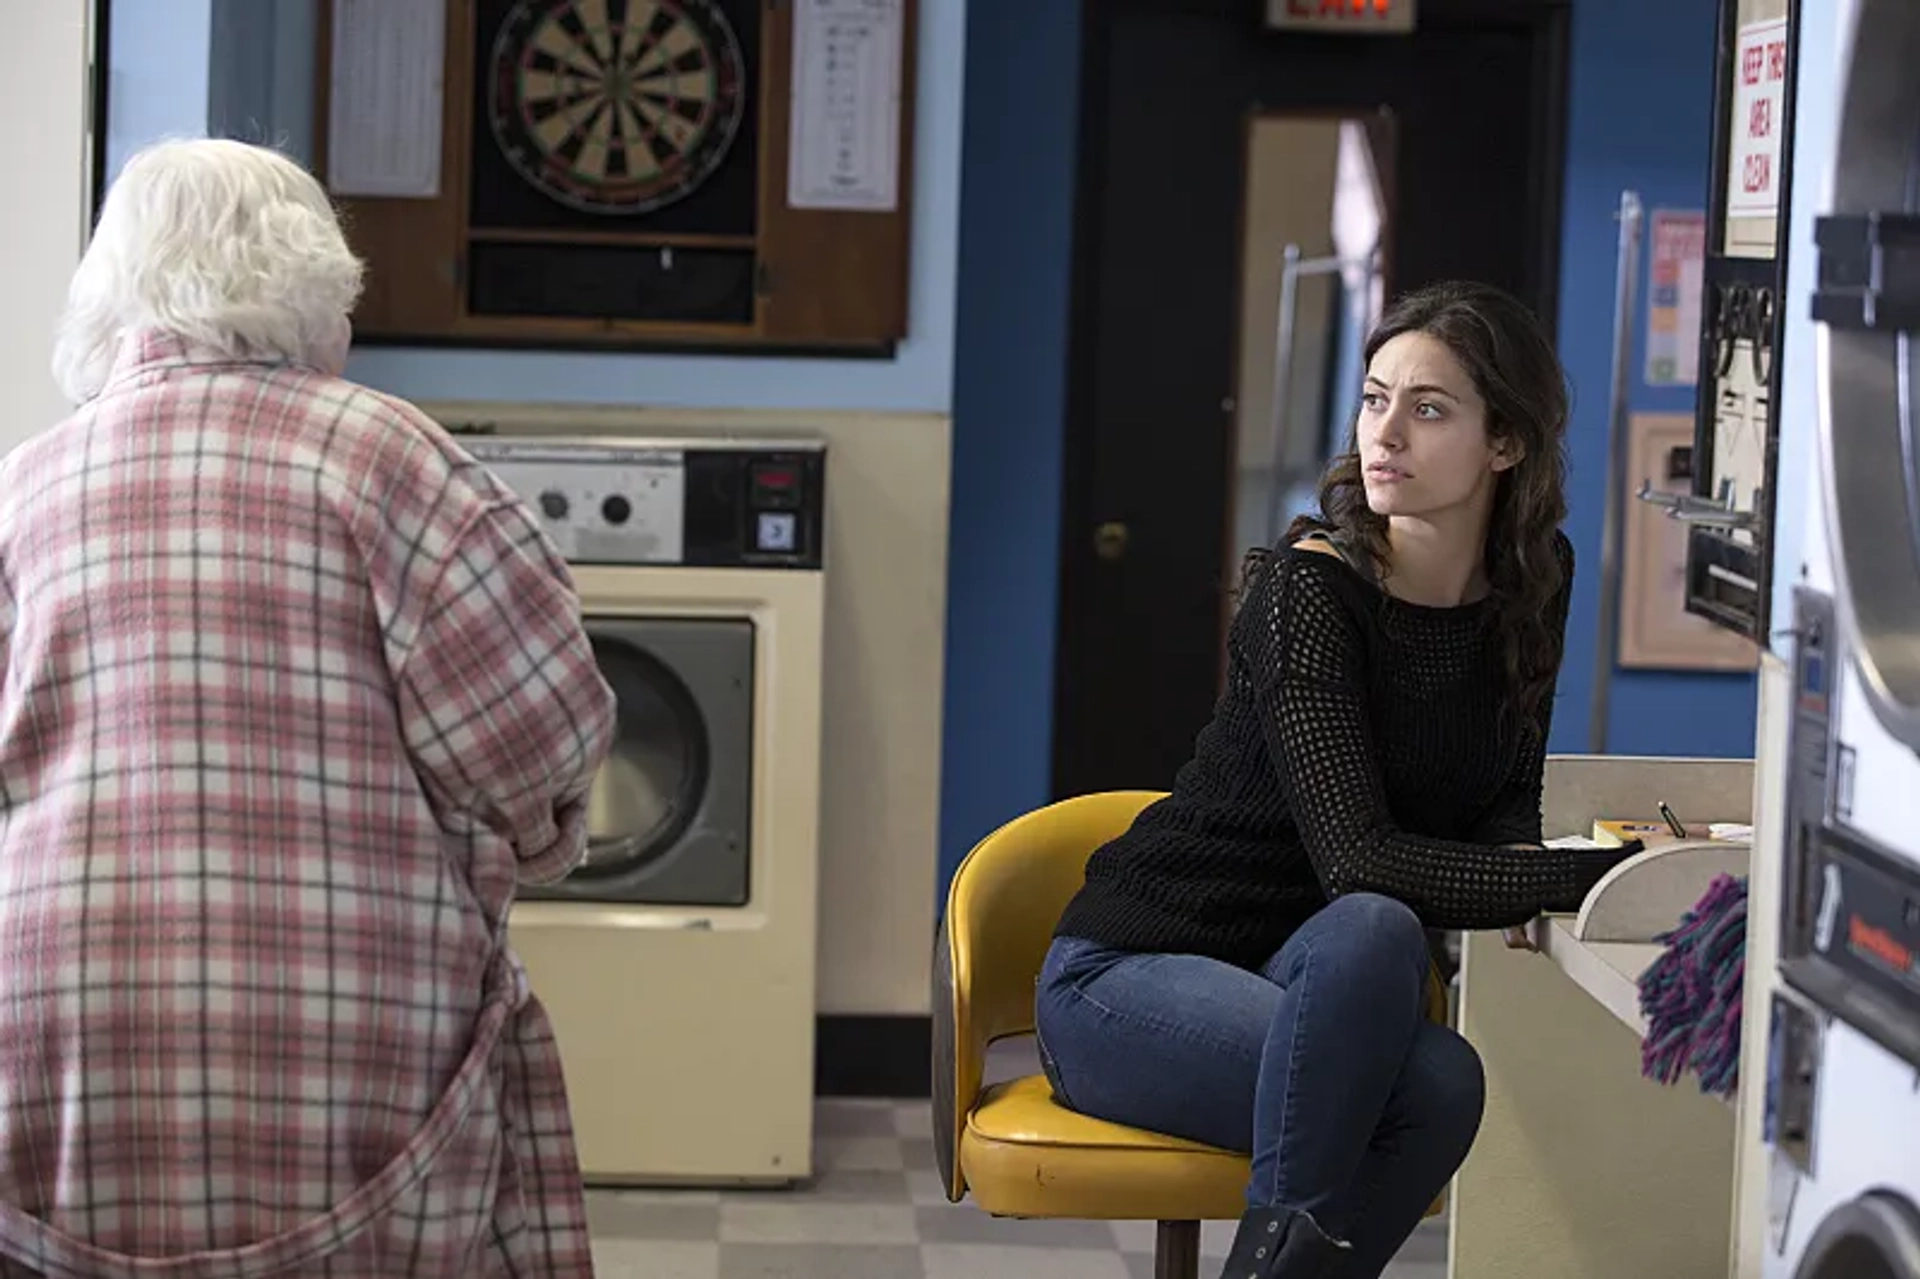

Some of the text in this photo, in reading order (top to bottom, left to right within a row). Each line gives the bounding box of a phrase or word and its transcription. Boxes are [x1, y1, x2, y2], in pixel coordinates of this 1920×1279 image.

[1742, 45, 1763, 86] KEEP
[1748, 98, 1771, 138] AREA
[1742, 153, 1771, 193] CLEAN
